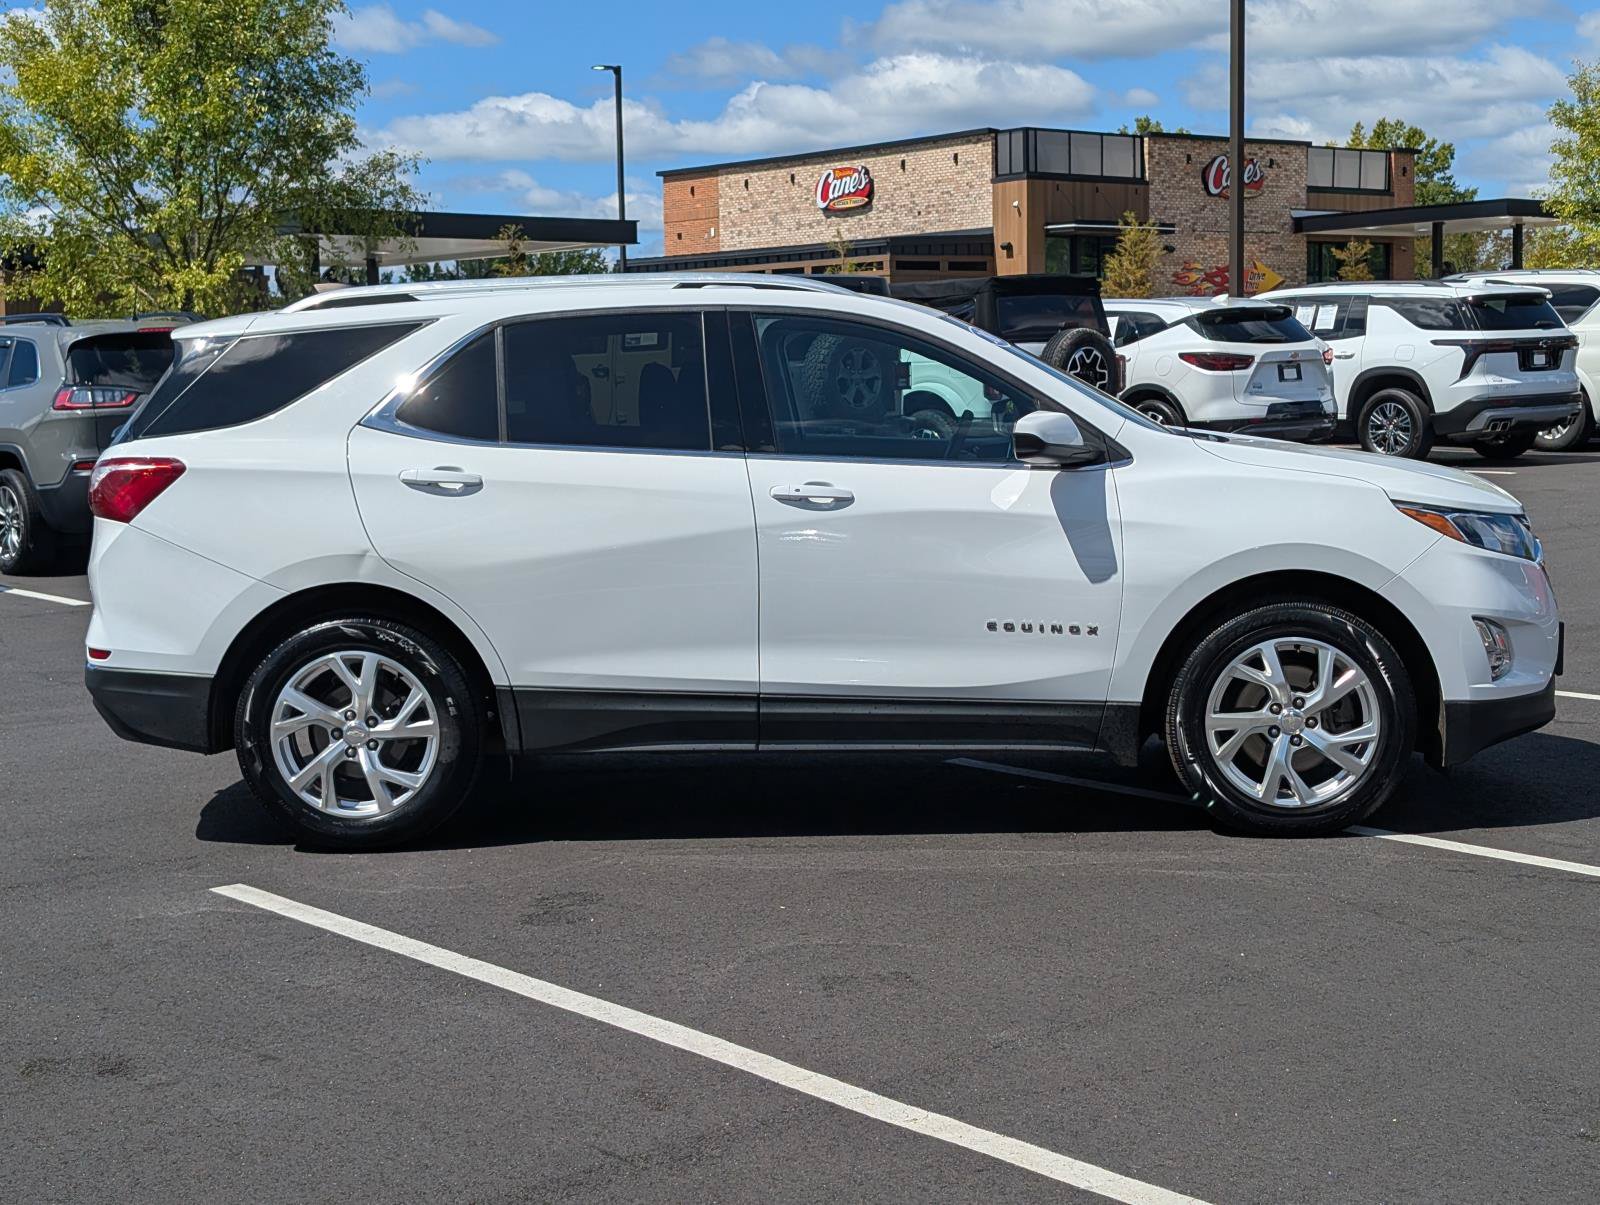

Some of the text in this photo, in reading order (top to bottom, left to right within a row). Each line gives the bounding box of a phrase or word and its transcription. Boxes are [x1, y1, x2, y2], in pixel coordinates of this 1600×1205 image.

[816, 165, 869, 208] Cane's
[1208, 155, 1264, 195] Cae's
[985, 620, 1100, 637] EQUINOX
